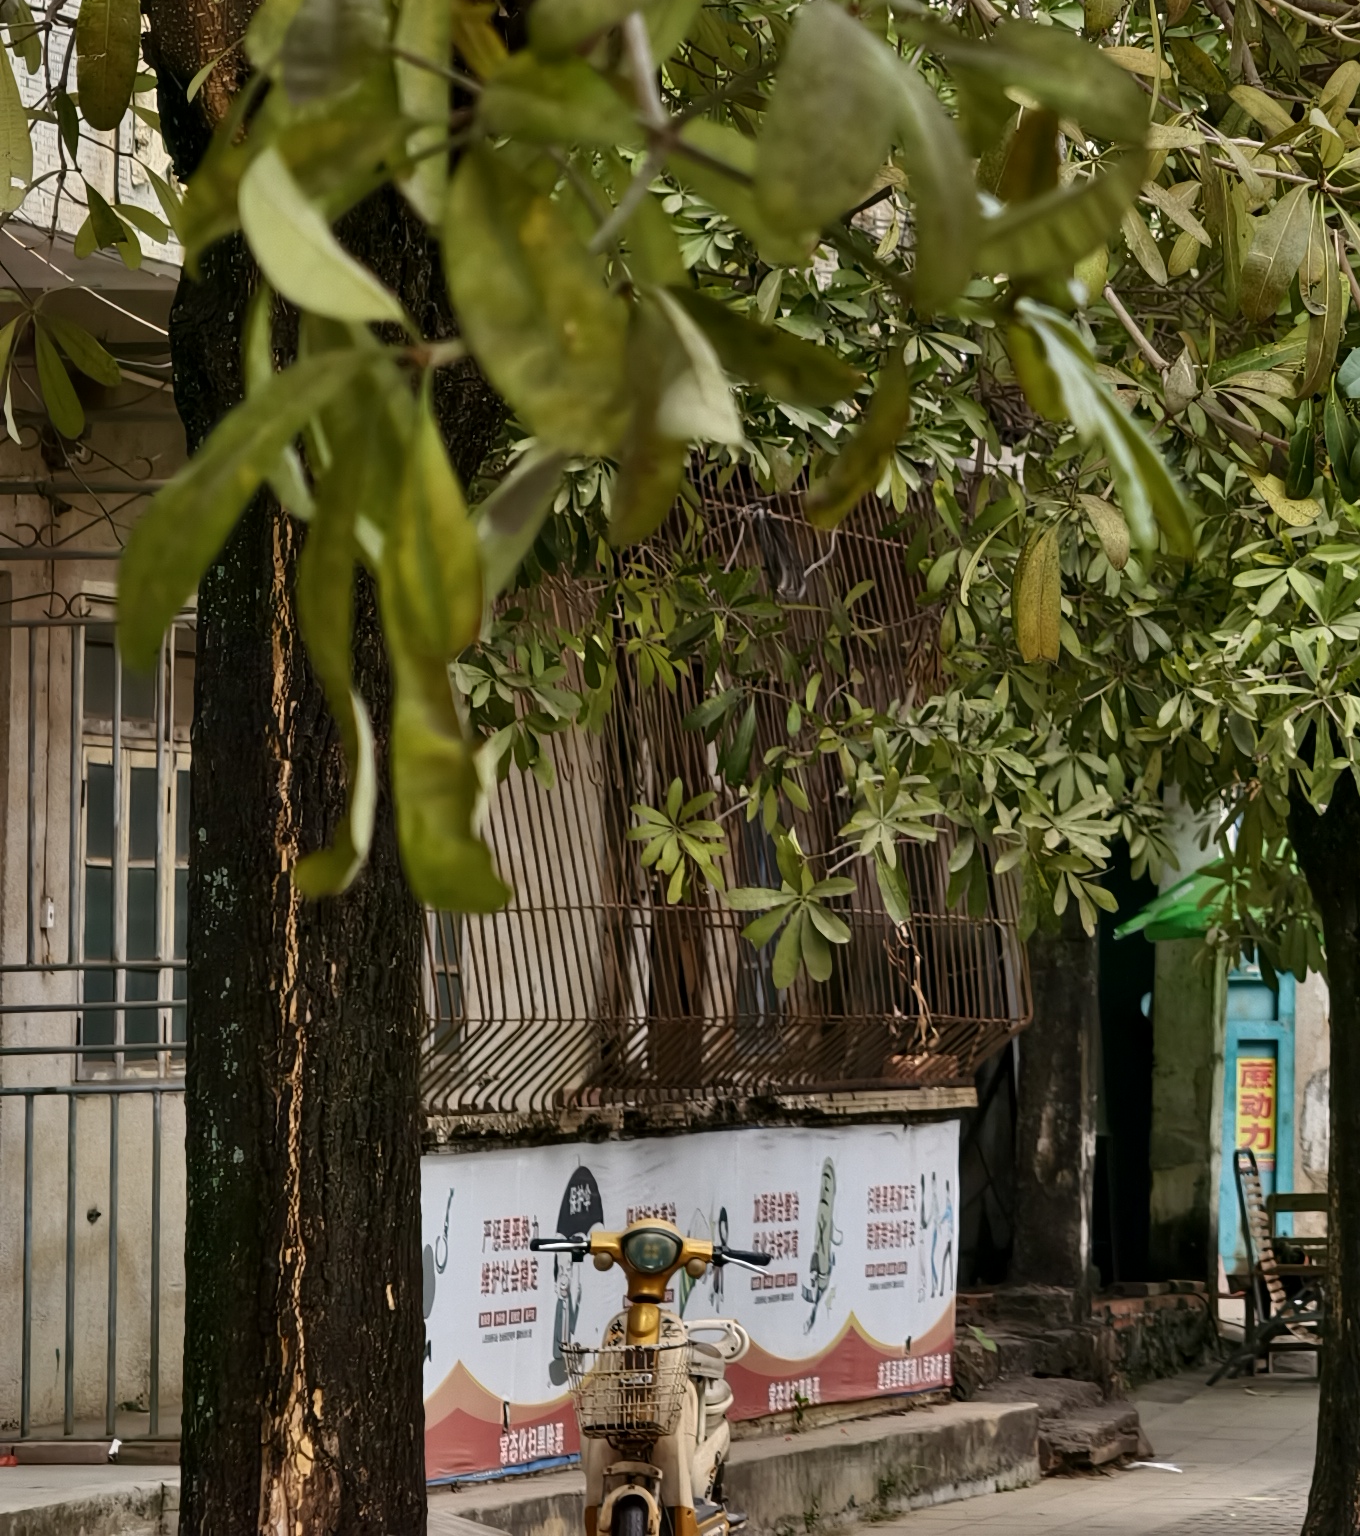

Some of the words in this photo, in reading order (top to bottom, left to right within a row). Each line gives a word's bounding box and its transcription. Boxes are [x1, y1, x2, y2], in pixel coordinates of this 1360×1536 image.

[1240, 1061, 1272, 1150] 蔗动力
[480, 1256, 538, 1297] 维护社会稳定
[499, 1422, 564, 1464] 常态化扫黑除恶
